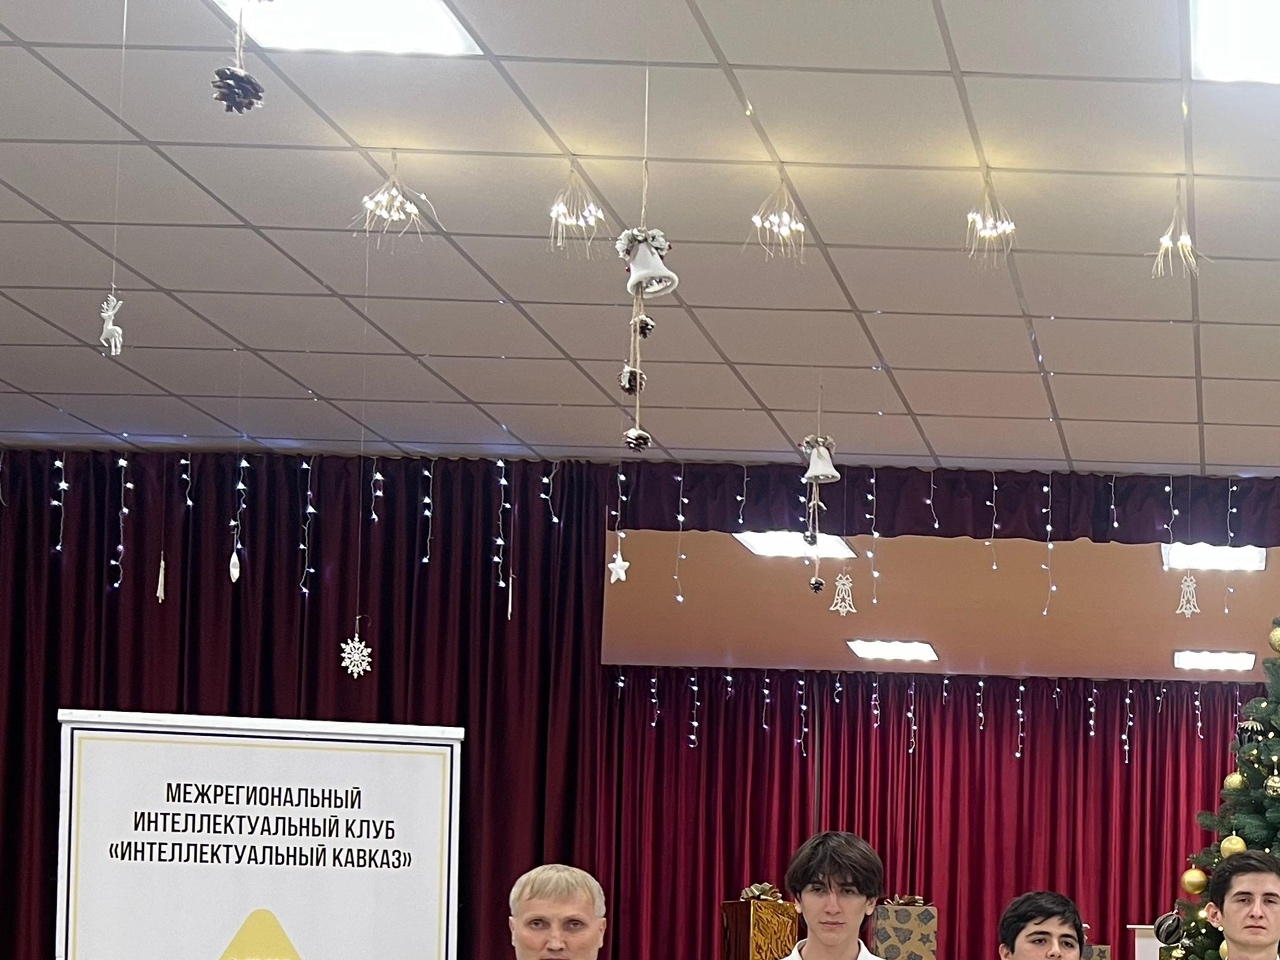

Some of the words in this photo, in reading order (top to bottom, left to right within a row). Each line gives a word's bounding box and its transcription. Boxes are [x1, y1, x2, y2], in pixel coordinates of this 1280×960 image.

[167, 782, 361, 809] МЕЖРЕГИОНАЛЬНЫЙ
[133, 811, 339, 838] ИНТЕЛЛЕКТУАЛЬНЫЙ
[345, 818, 395, 840] КЛУБ
[109, 841, 326, 867] «ИНТЕЛЛЕКТУАЛЬНЫЙ
[333, 847, 412, 869] КАВКАЗ»
